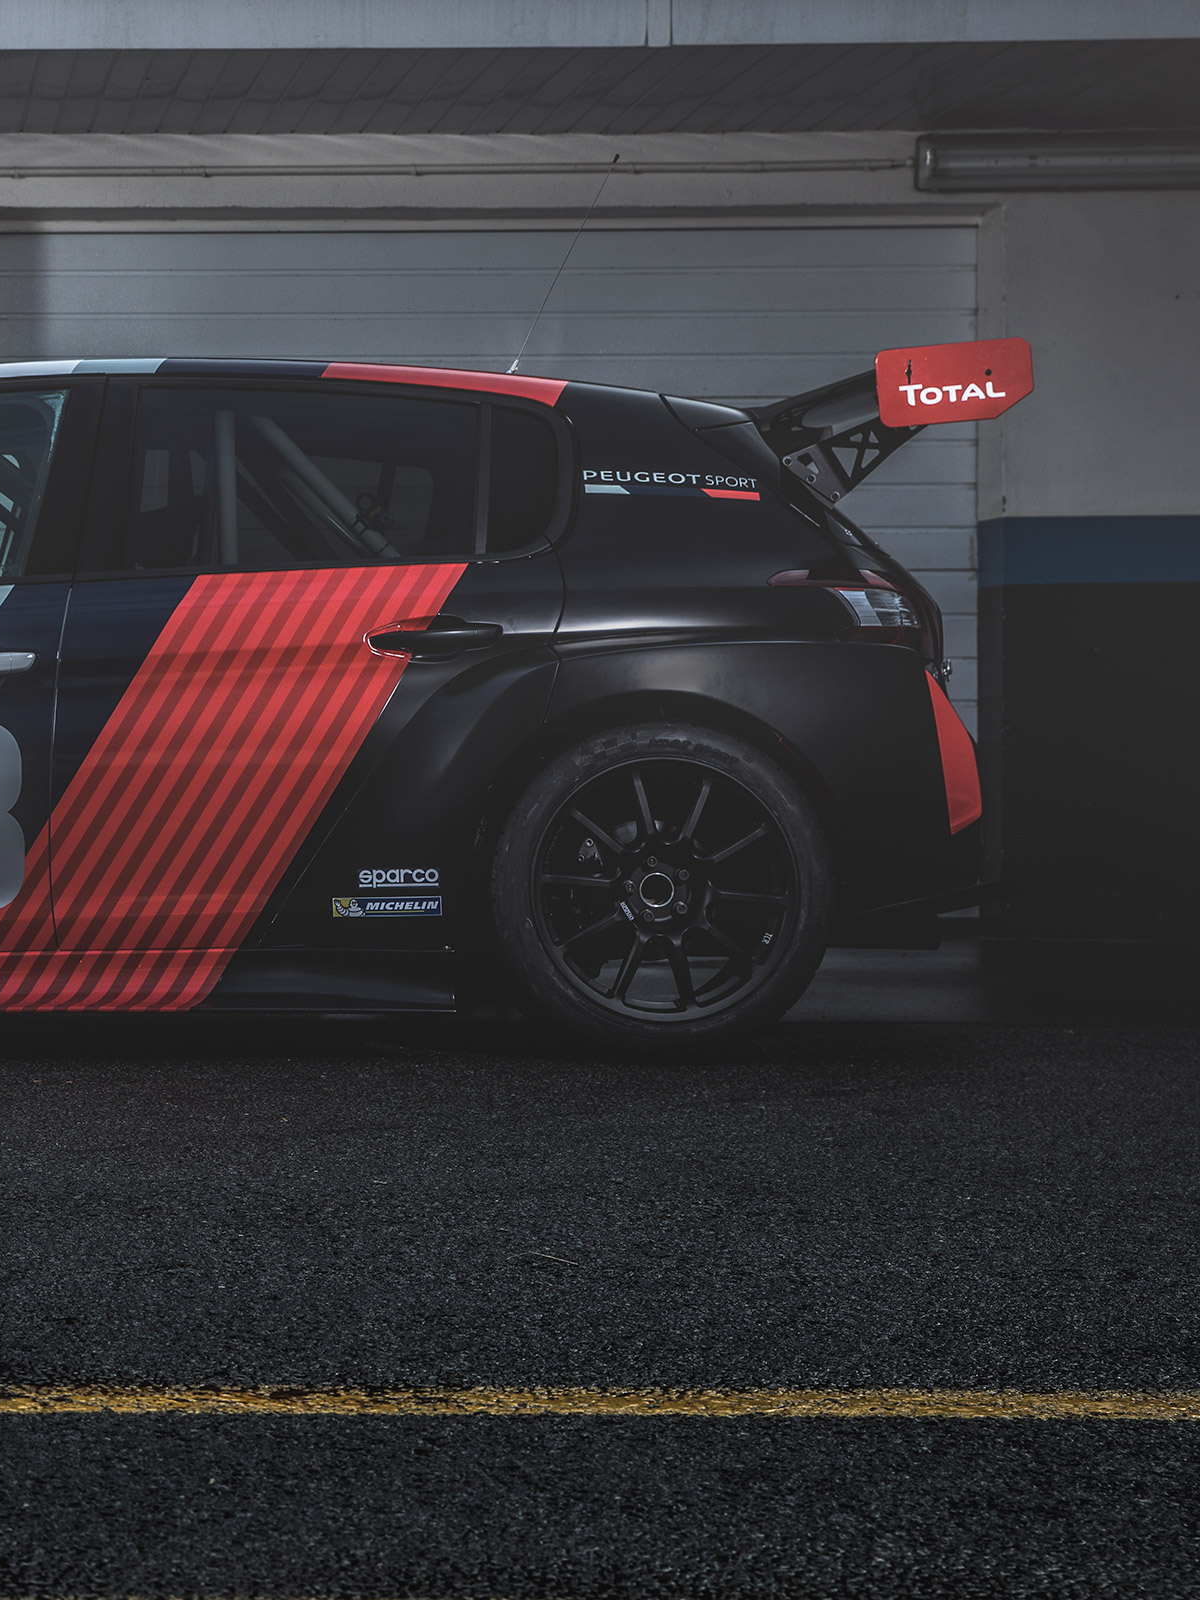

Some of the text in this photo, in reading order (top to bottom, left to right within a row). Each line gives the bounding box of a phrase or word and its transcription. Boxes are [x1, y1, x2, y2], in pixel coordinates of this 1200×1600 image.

[899, 381, 1006, 407] TOTAL
[582, 470, 757, 489] PEUGEOT SPORT
[358, 868, 440, 889] sparco
[365, 901, 439, 911] MICHELIN
